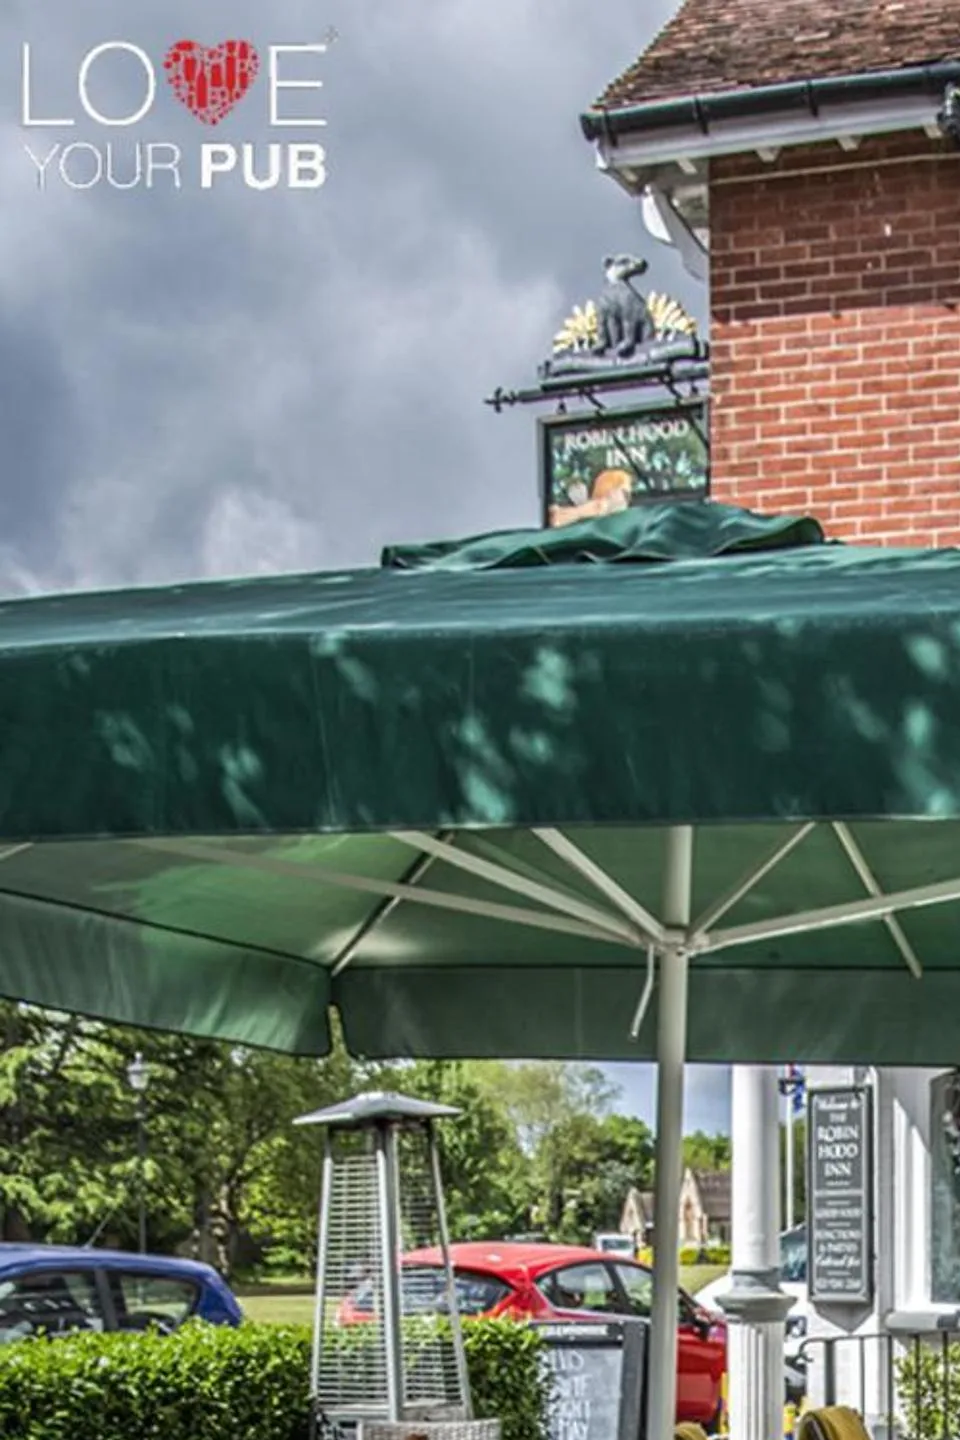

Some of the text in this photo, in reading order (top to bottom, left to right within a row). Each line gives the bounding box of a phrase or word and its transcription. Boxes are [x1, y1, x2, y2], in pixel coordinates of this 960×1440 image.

[605, 446, 648, 467] INN
[817, 1125, 859, 1142] ROBIN
[817, 1143, 859, 1160] HOOD
[824, 1162, 852, 1177] INN
